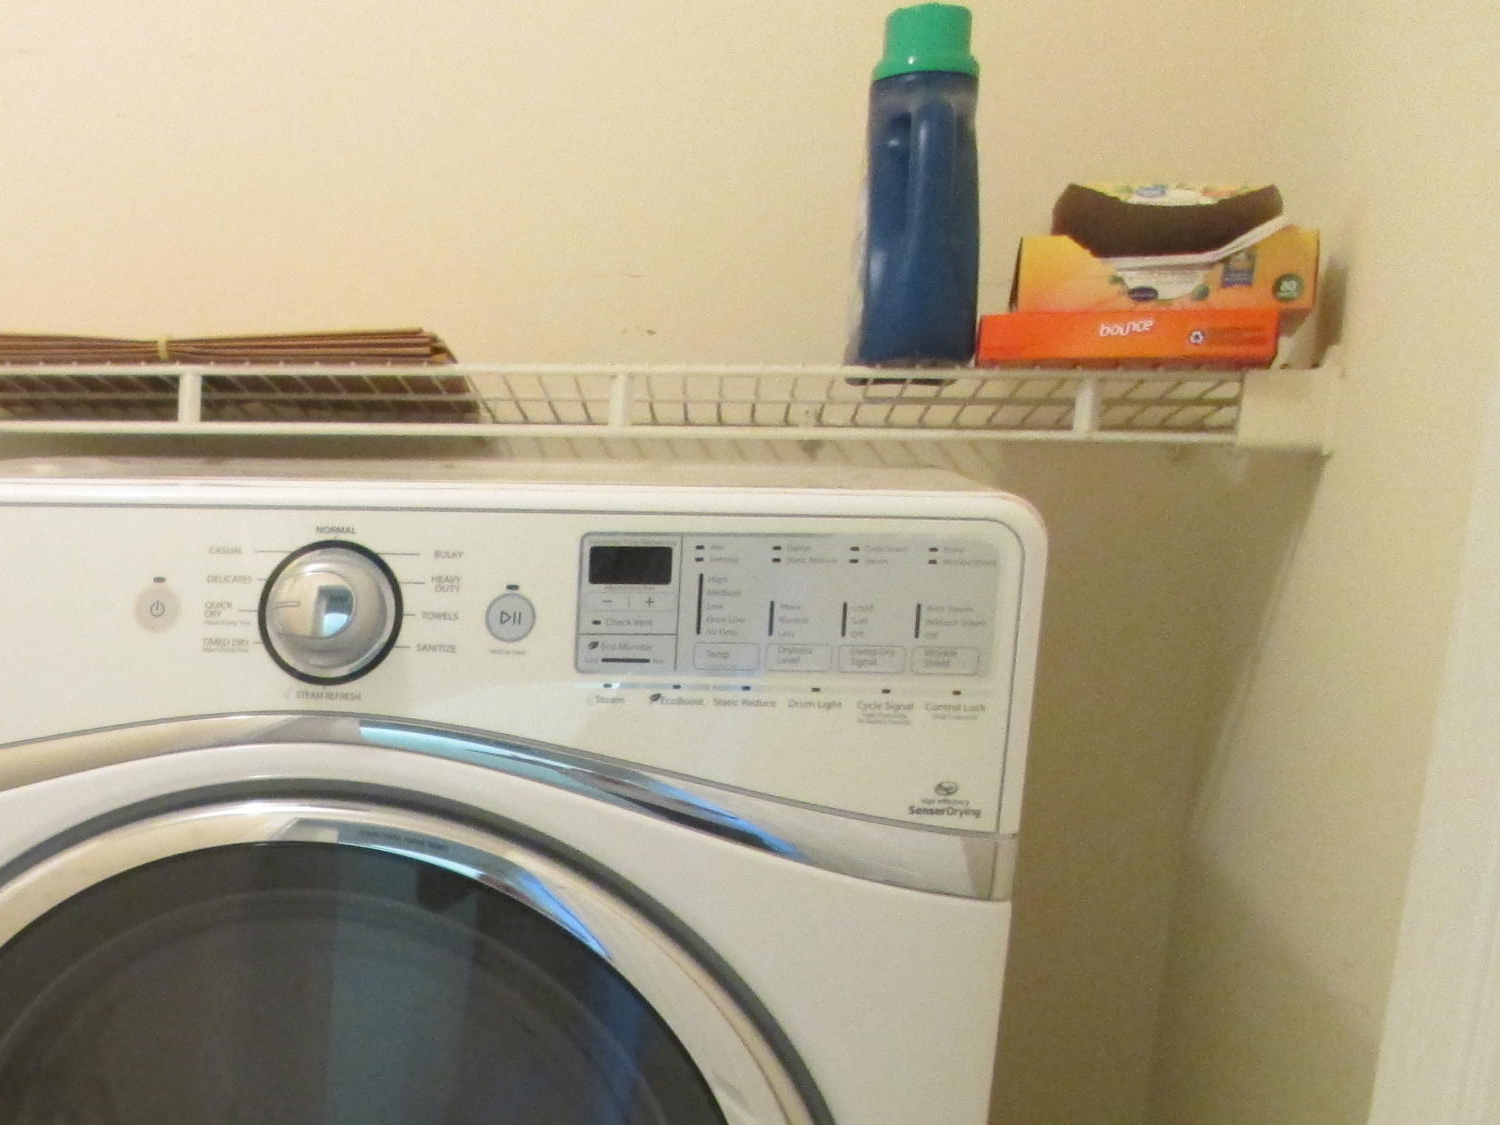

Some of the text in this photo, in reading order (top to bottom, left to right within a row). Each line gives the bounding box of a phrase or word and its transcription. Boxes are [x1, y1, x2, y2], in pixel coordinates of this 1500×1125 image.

[1099, 318, 1154, 337] bounce
[316, 526, 357, 535] NORMAL
[208, 546, 243, 555] CASUAL
[434, 550, 463, 559] BULKY
[206, 574, 252, 584] DELICATES
[431, 575, 461, 584] HEAVY
[435, 584, 460, 593] DUTY
[204, 601, 233, 610] QUICK
[204, 610, 221, 618] DRY
[421, 611, 459, 621] TOWELS
[232, 638, 249, 647] DRY
[416, 643, 458, 653] SANITIZE
[660, 697, 704, 705] EcoBoost
[788, 699, 842, 710] Drum Light
[857, 701, 914, 712] Cycle Signal
[925, 703, 961, 712] Control
